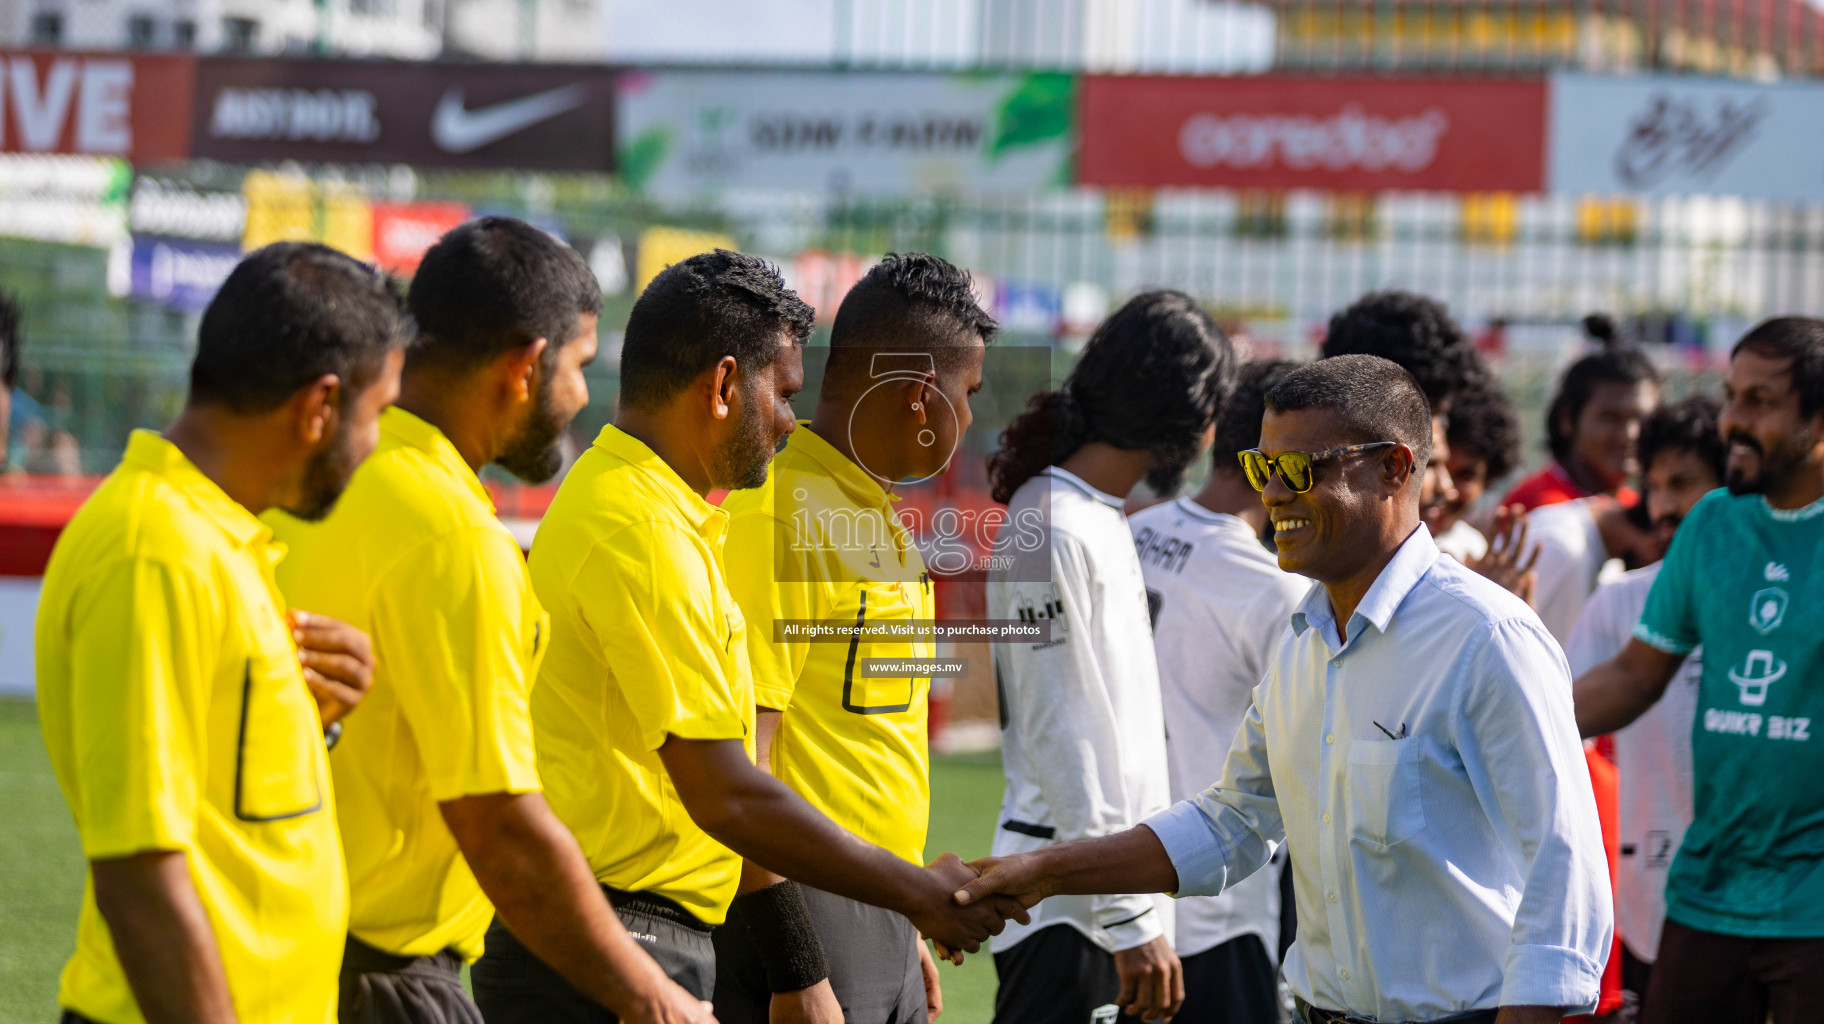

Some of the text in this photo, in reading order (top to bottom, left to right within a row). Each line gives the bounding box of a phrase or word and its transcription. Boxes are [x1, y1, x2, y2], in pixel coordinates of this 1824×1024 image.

[0, 57, 133, 152] VE
[1180, 102, 1448, 172] ooredoo
[1767, 715, 1811, 741] BIZ
